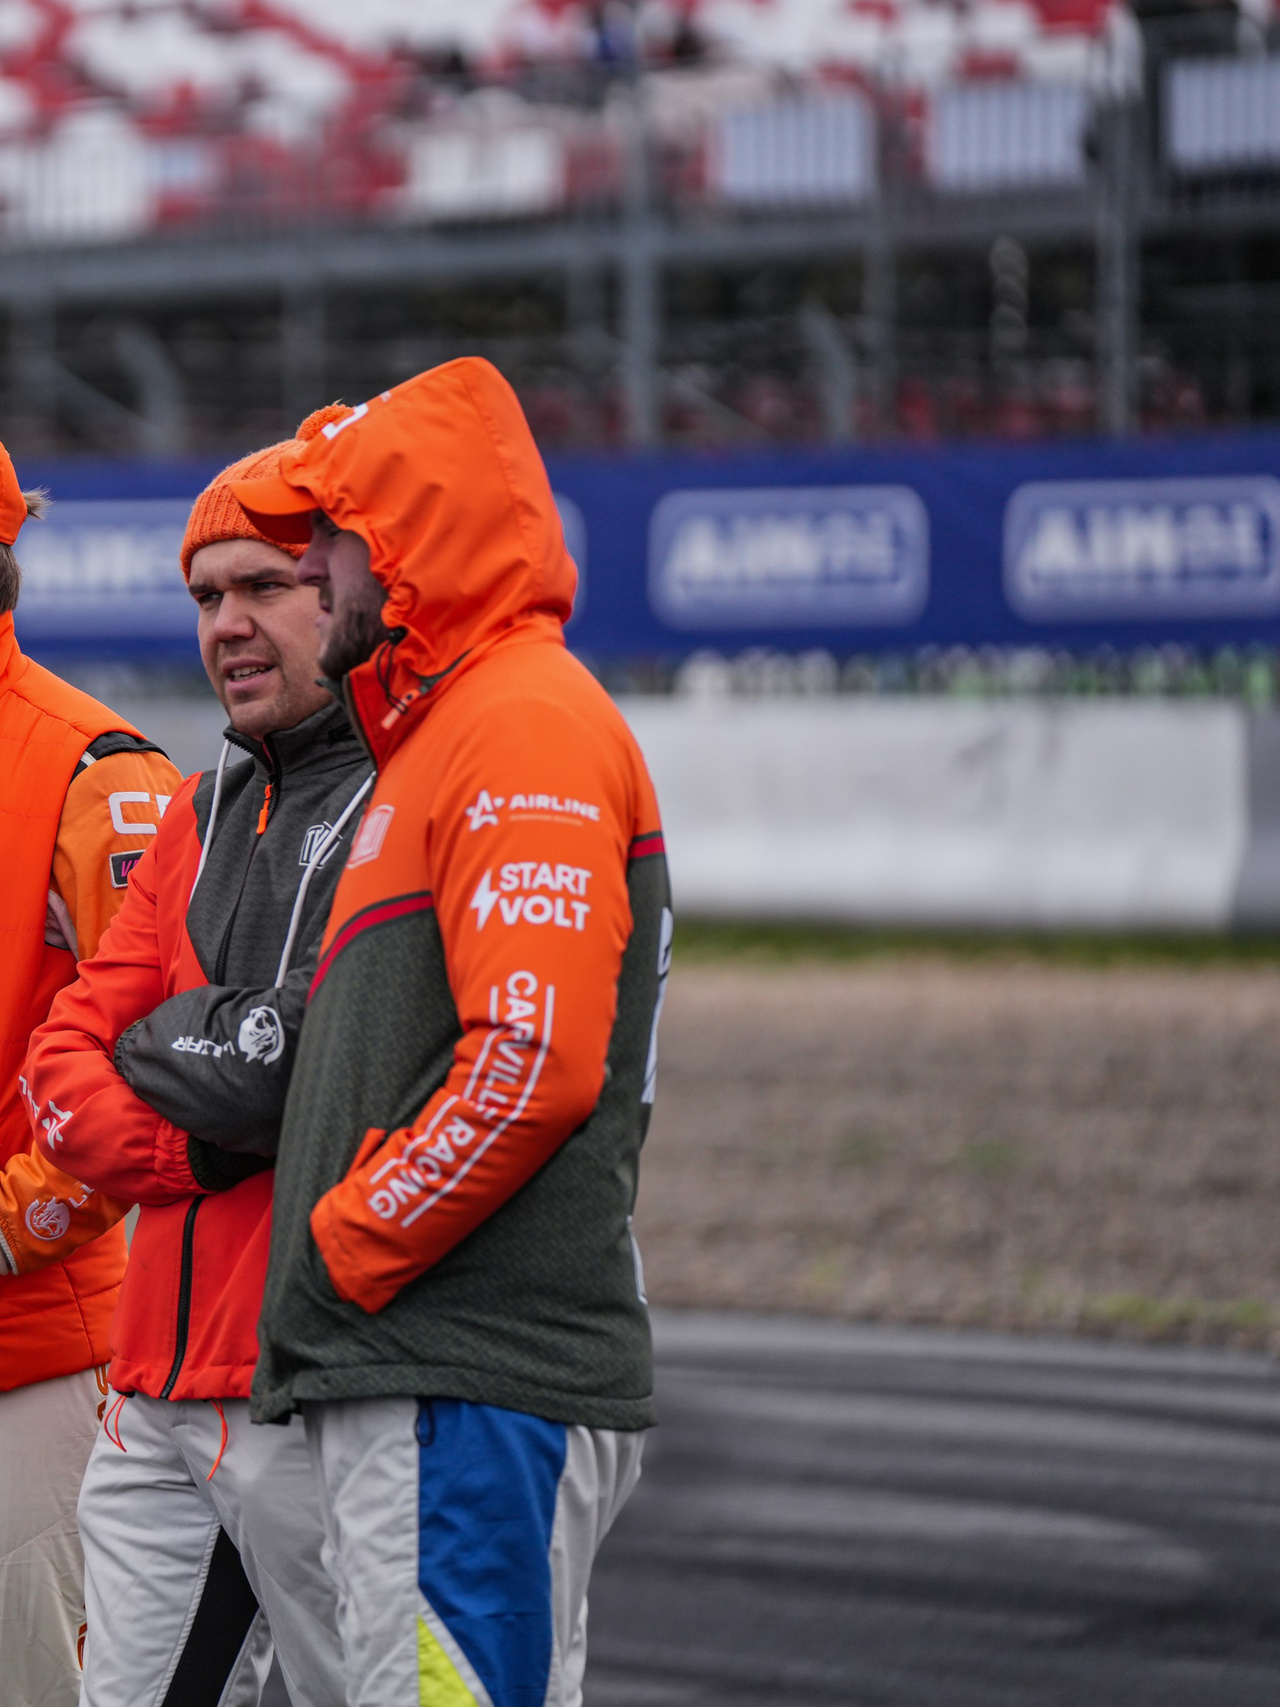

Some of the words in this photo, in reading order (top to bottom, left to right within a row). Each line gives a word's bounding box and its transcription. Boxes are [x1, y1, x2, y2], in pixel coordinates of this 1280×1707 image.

[509, 794, 600, 821] AIRLINE
[500, 862, 592, 896] START
[498, 895, 591, 931] VOLT
[369, 1115, 477, 1219] RACING
